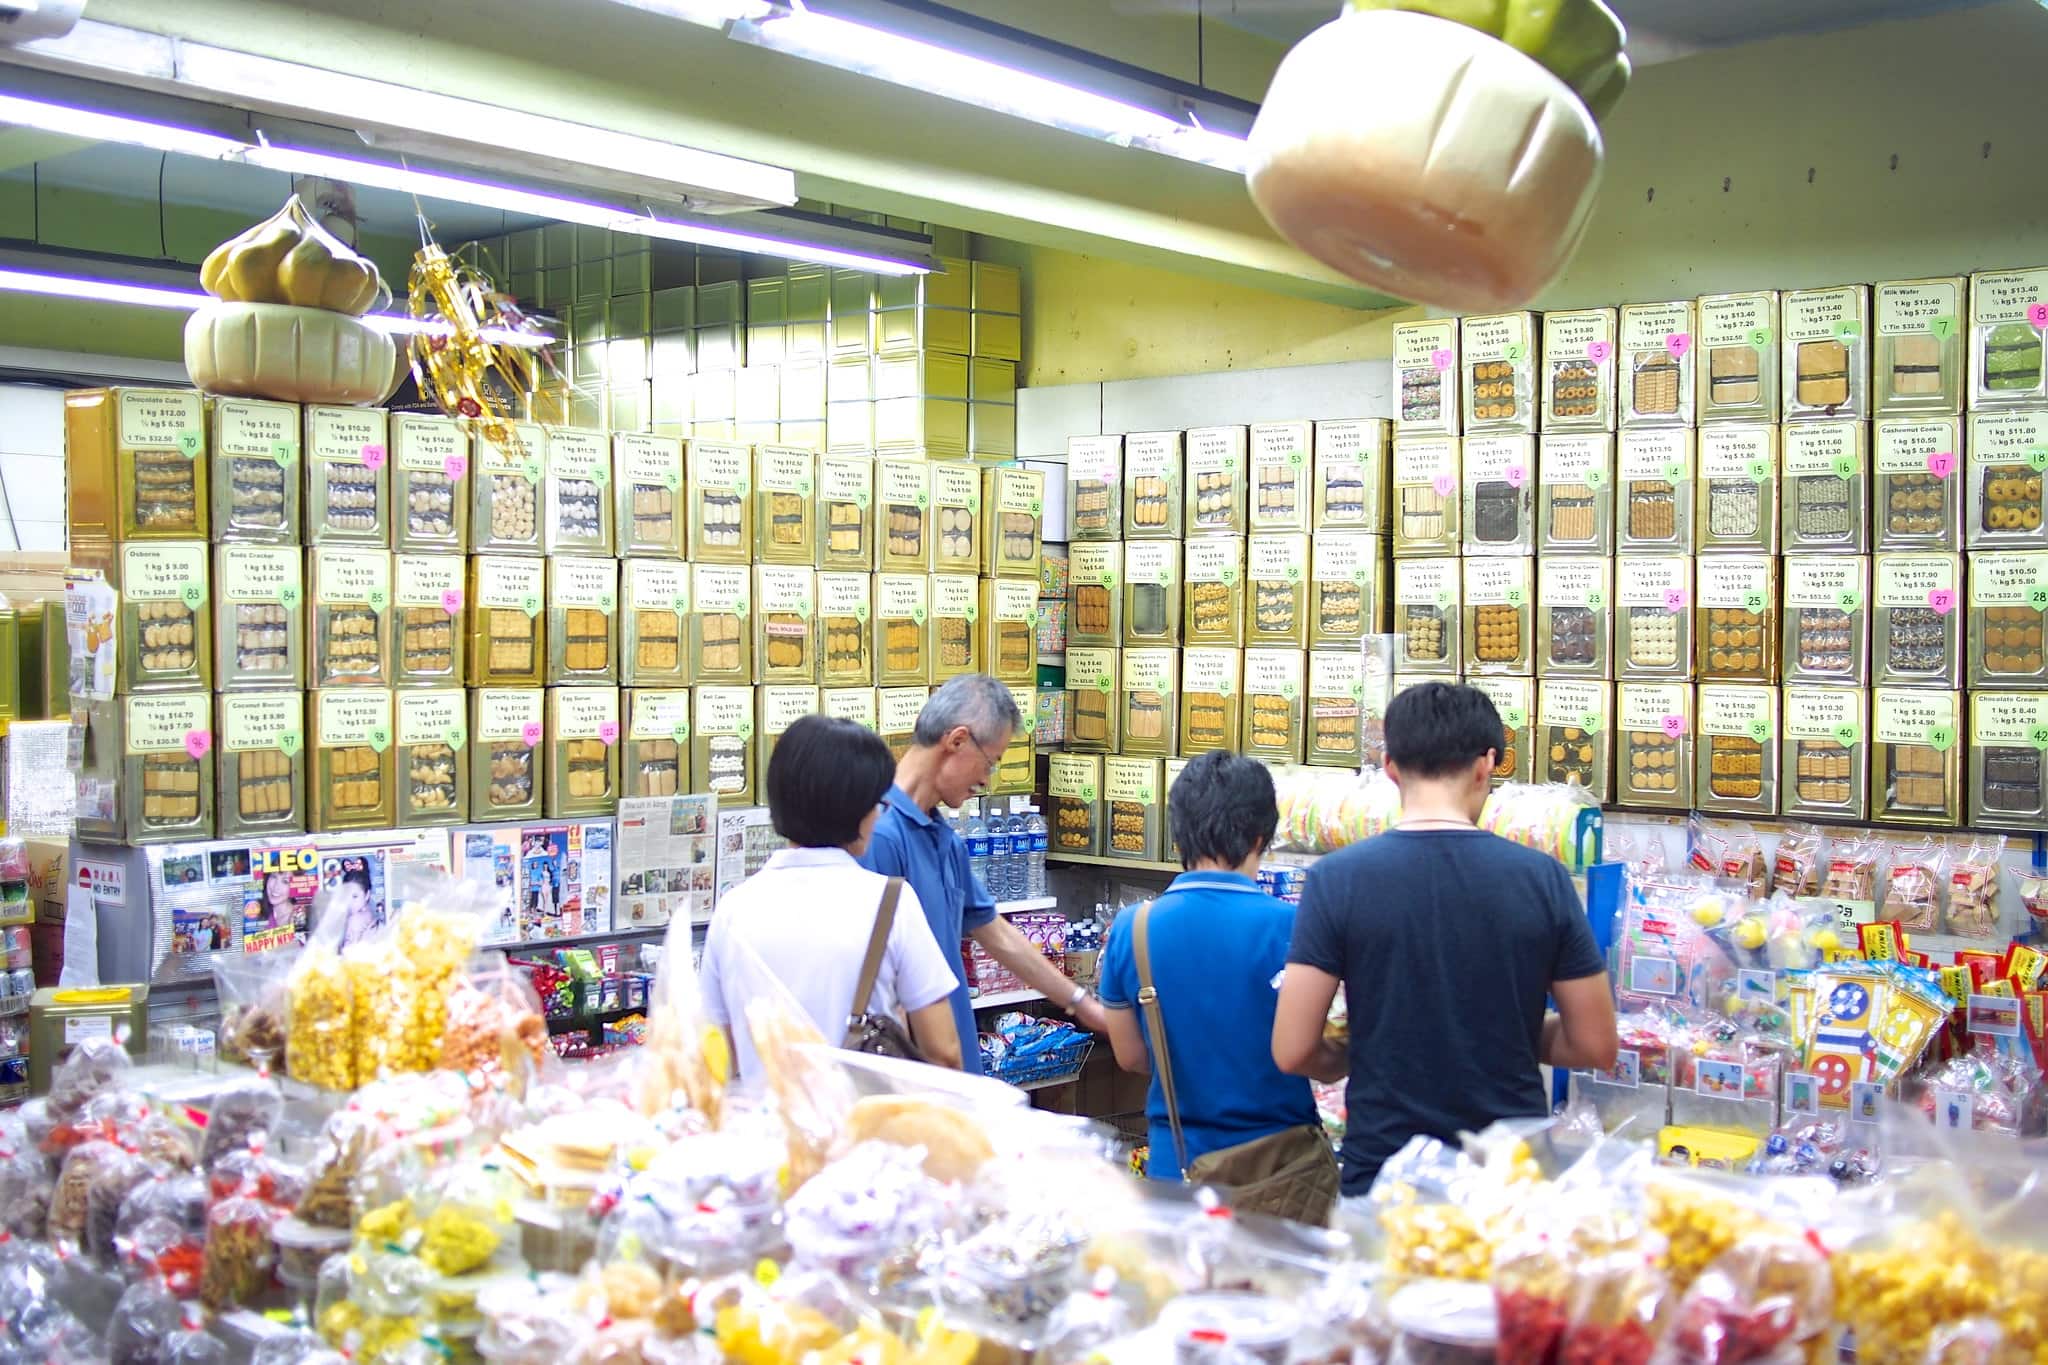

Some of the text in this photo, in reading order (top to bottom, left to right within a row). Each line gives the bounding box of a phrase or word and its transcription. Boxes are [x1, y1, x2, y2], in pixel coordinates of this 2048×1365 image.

[1980, 277, 2002, 285] Durian
[1898, 288, 1919, 296] Wafer
[2010, 286, 2038, 295] $13.40
[1736, 300, 1754, 308] Wafer
[1914, 298, 1940, 306] $13.40
[1731, 311, 1756, 319] $13.40
[2036, 307, 2047, 320] 8
[1938, 321, 1948, 334] 7
[1672, 337, 1683, 349] 4
[1754, 333, 1764, 345] 5
[1509, 347, 1518, 359] 2
[1594, 345, 1603, 357] 3
[160, 408, 186, 417] $12.00
[1977, 416, 2029, 425] Almond Cookie
[184, 437, 196, 448] 70
[279, 448, 289, 459] 71
[369, 451, 380, 461] 72
[1358, 453, 1368, 462] 54
[2033, 452, 2046, 463] 18
[1225, 459, 1234, 468] 52
[1291, 455, 1302, 463] 53
[1839, 463, 1850, 473] 16
[1935, 459, 1947, 471] 17
[1668, 467, 1679, 477] 14
[1753, 465, 1764, 475] 15
[1509, 470, 1521, 480] 12
[1589, 472, 1600, 483] 13
[858, 494, 867, 504] 79
[918, 495, 927, 504] 80
[1032, 504, 1041, 512] 82
[129, 550, 161, 558] Osborne
[1978, 557, 2000, 565] Ginger
[1288, 569, 1299, 578] 58
[1355, 571, 1366, 579] 59
[2009, 567, 2037, 575] $10.50
[1103, 575, 1112, 584] 55
[1224, 572, 1234, 580] 57
[186, 588, 200, 599] 83
[283, 590, 295, 600] 84
[371, 593, 383, 602] 85
[1438, 594, 1448, 602] 21
[1509, 591, 1520, 600] 22
[2032, 592, 2047, 602] 28
[1589, 594, 1600, 603] 23
[1668, 594, 1680, 603] 24
[1748, 596, 1761, 606] 25
[1842, 595, 1854, 605] 26
[1935, 595, 1948, 605] 27
[527, 600, 537, 609] 87
[675, 599, 684, 609] 89
[1100, 679, 1110, 687] 60
[1220, 682, 1229, 690] 62
[1283, 685, 1293, 693] 63
[1978, 695, 2014, 703] Chocolate
[134, 700, 155, 708] White
[1508, 713, 1519, 721] 36
[1585, 717, 1595, 726] 37
[1667, 720, 1678, 729] 38
[1753, 725, 1766, 735] 39
[1840, 729, 1853, 738] 40
[374, 732, 384, 742] 98
[1934, 732, 1945, 742] 41
[2034, 730, 2048, 741] 42
[191, 738, 204, 748] 96
[283, 736, 294, 747] 97
[1083, 788, 1092, 797] 65
[1140, 791, 1150, 799] 66
[93, 884, 120, 897] NO ENTRY
[245, 936, 276, 953] HAPPY
